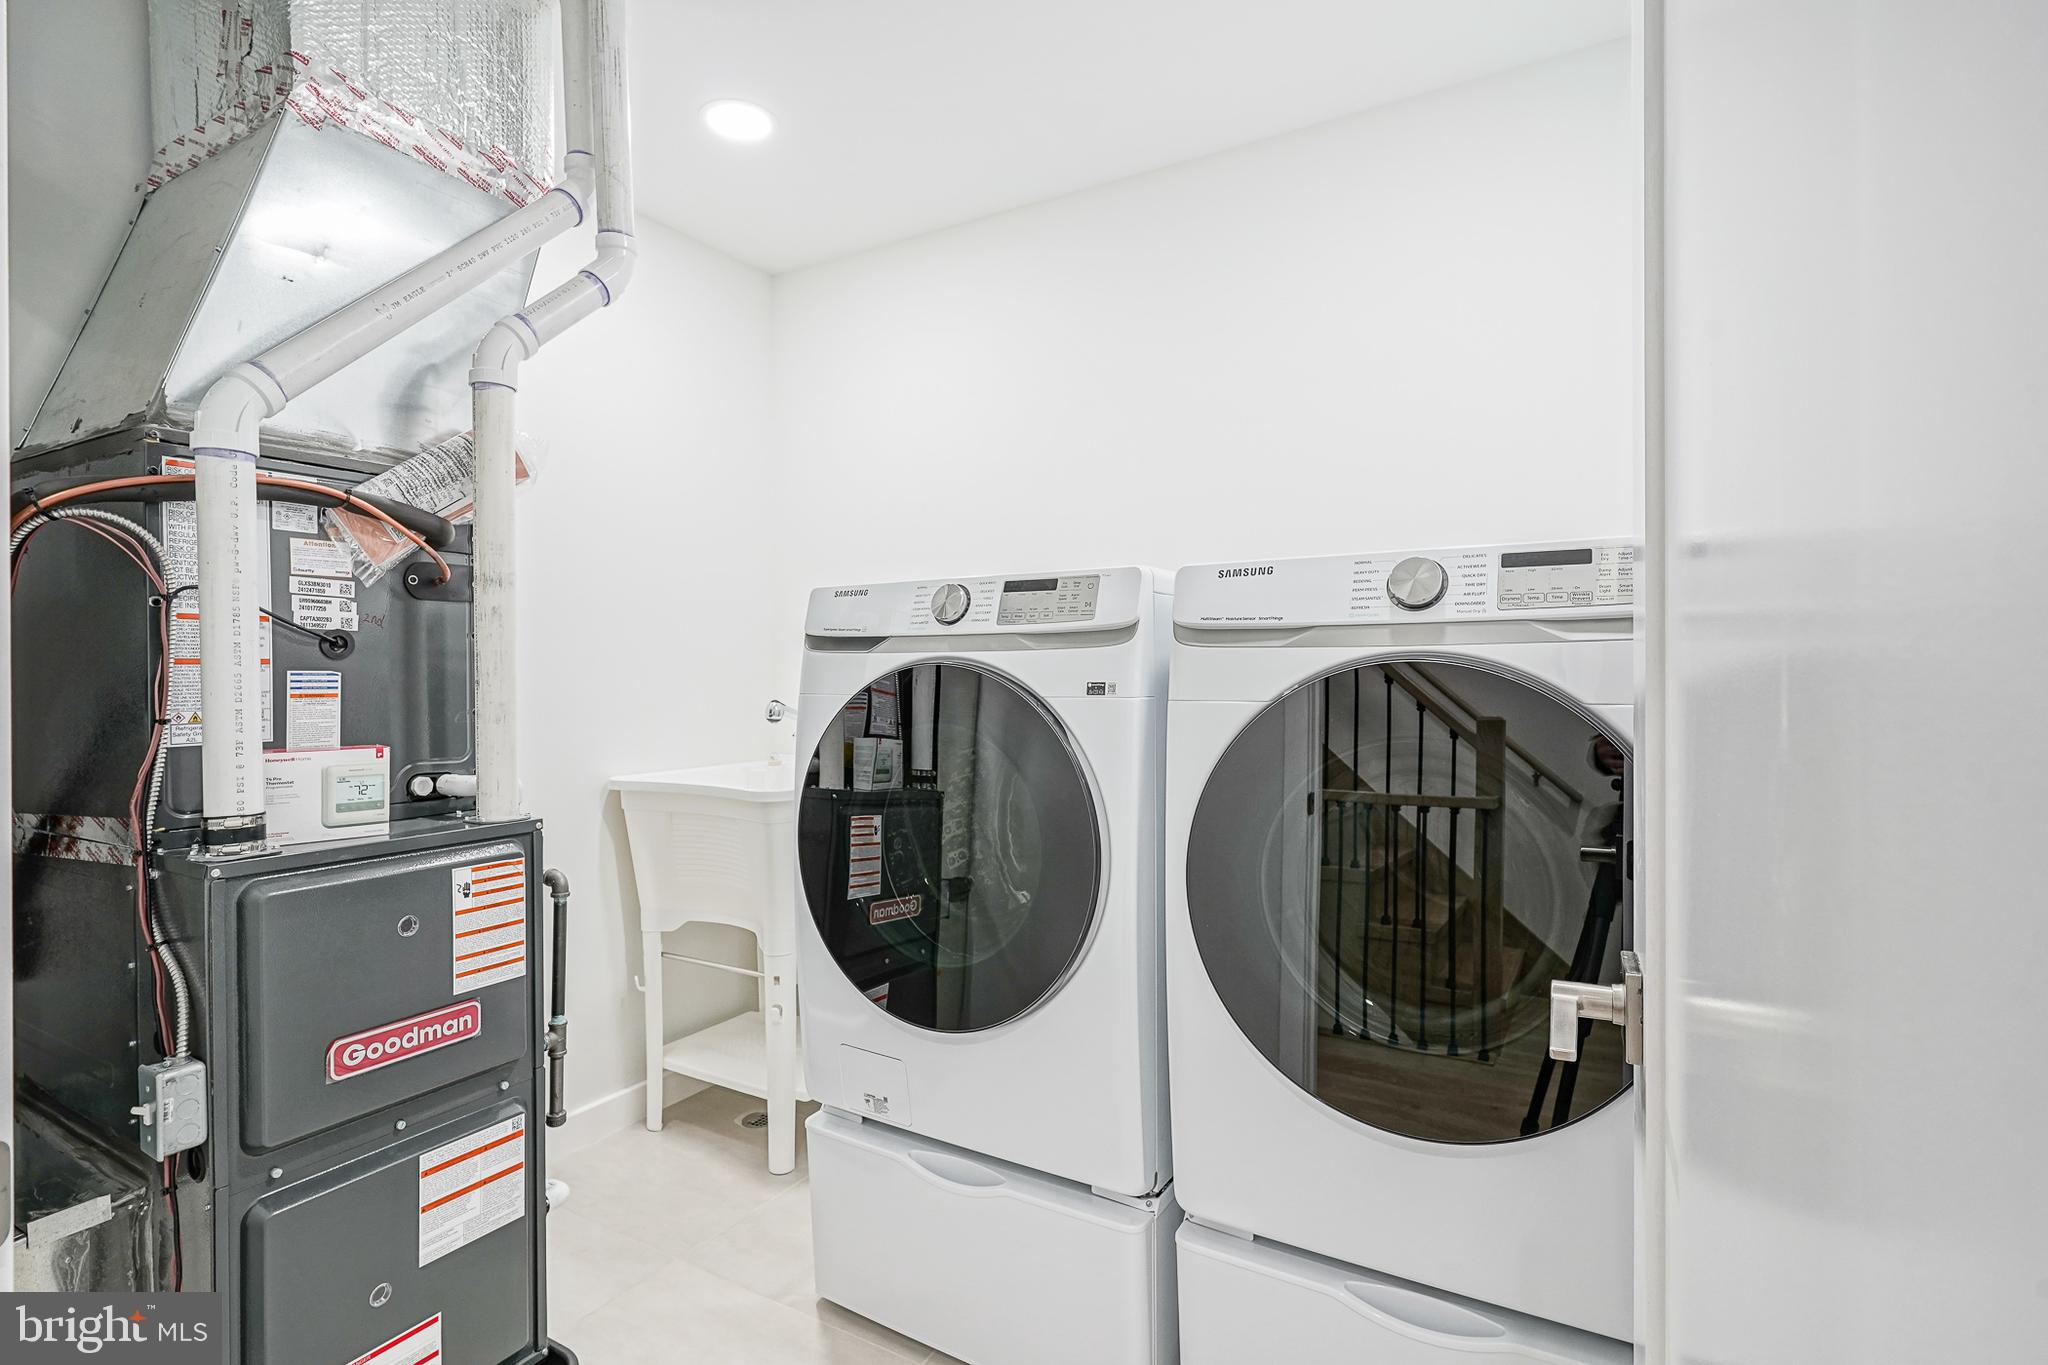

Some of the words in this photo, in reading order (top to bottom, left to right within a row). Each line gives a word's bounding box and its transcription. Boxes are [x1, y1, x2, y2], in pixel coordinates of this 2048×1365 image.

[403, 286, 426, 303] EAGLE
[230, 464, 238, 488] Code
[169, 509, 184, 517] RISK
[171, 559, 198, 567] GNITION
[1217, 565, 1274, 579] SAMSUNG
[834, 589, 869, 598] SAMSUNG
[232, 606, 240, 636] D1785
[233, 642, 241, 667] ASTM
[234, 673, 243, 703] D2665
[235, 709, 243, 733] ASTM
[235, 739, 244, 757] 73F
[236, 776, 245, 793] PSI
[354, 784, 368, 796] 72
[236, 800, 245, 815] 80
[342, 1014, 472, 1067] Goodman
